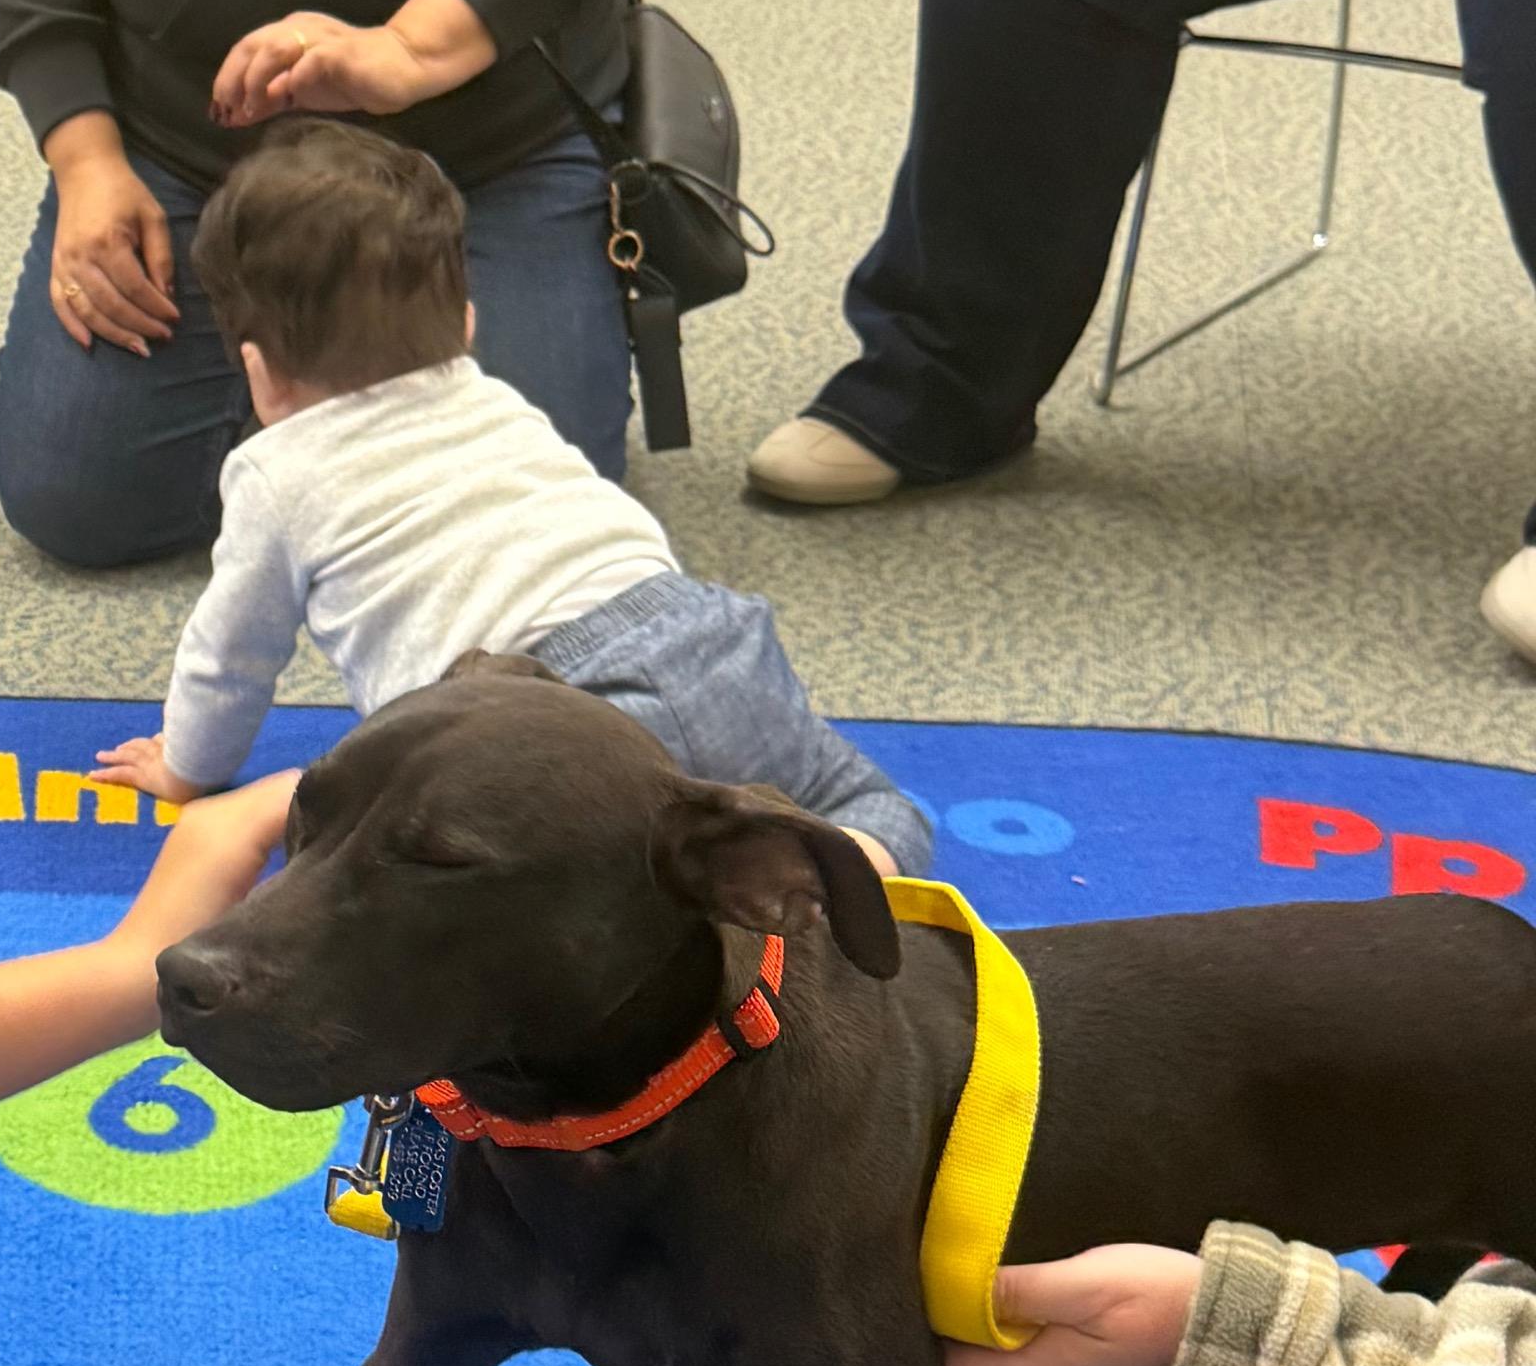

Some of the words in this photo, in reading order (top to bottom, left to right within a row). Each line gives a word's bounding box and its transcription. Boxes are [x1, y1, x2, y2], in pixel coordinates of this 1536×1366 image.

[88, 1054, 218, 1154] 6
[400, 1167, 416, 1201] CALL
[414, 1144, 432, 1199] FOUND
[425, 1162, 444, 1215] FOSTER
